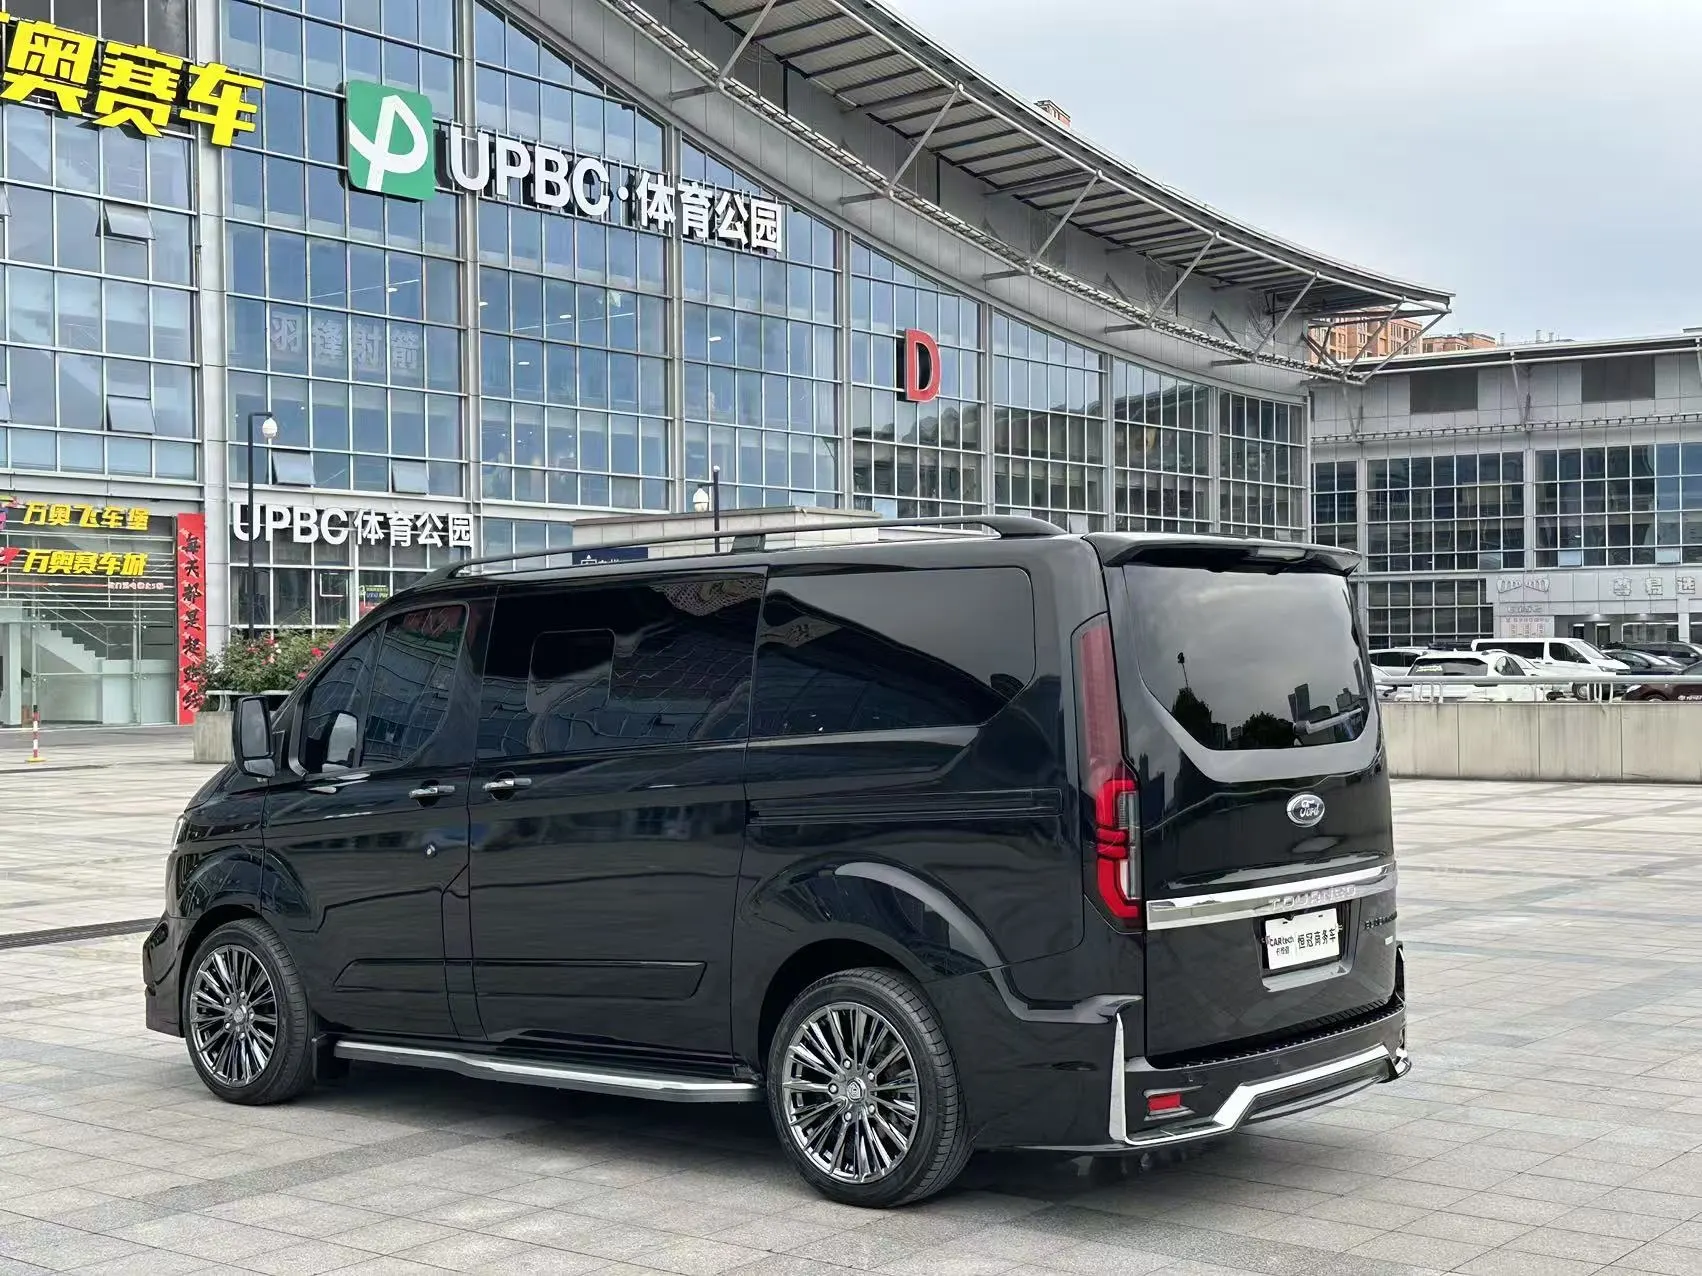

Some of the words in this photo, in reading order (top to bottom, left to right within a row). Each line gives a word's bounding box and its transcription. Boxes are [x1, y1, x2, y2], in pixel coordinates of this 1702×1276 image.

[0, 12, 264, 147] 奥赛车
[903, 328, 942, 403] D
[22, 502, 149, 531] 万奥飞车堡
[22, 549, 148, 576] 万奥赛车城
[1268, 884, 1356, 911] TOURNEO
